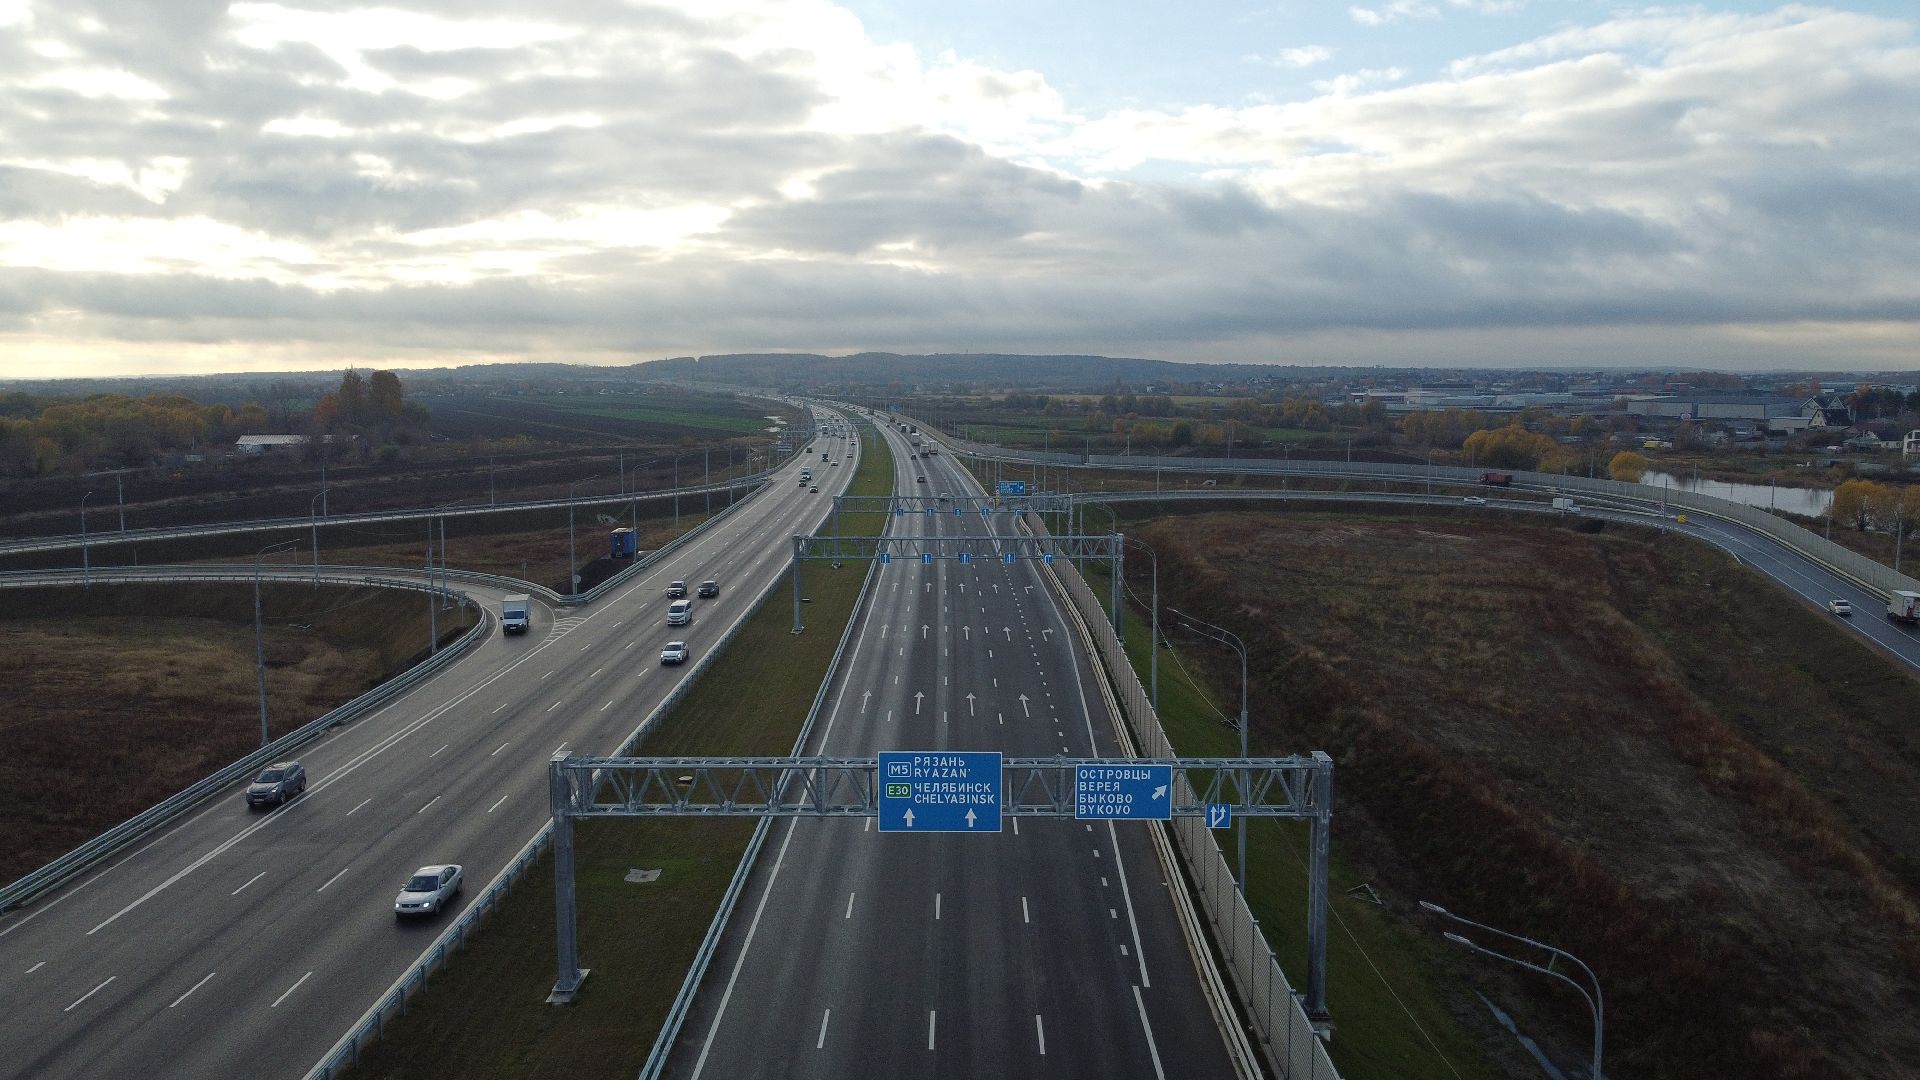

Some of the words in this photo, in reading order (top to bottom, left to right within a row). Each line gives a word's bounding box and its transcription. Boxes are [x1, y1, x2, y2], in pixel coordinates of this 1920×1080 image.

[914, 756, 965, 767] РЯЗАНЬ
[1079, 769, 1151, 781] ОСТРОВЦЫ
[888, 786, 909, 795] E30
[914, 782, 991, 793] ЧЕЛЯБИНСК
[1079, 781, 1120, 792] ВЕРЕЯ
[914, 794, 995, 804] CHELYABINSK
[1079, 793, 1133, 804] БЫКОВО
[1079, 804, 1131, 815] BYKOVO
